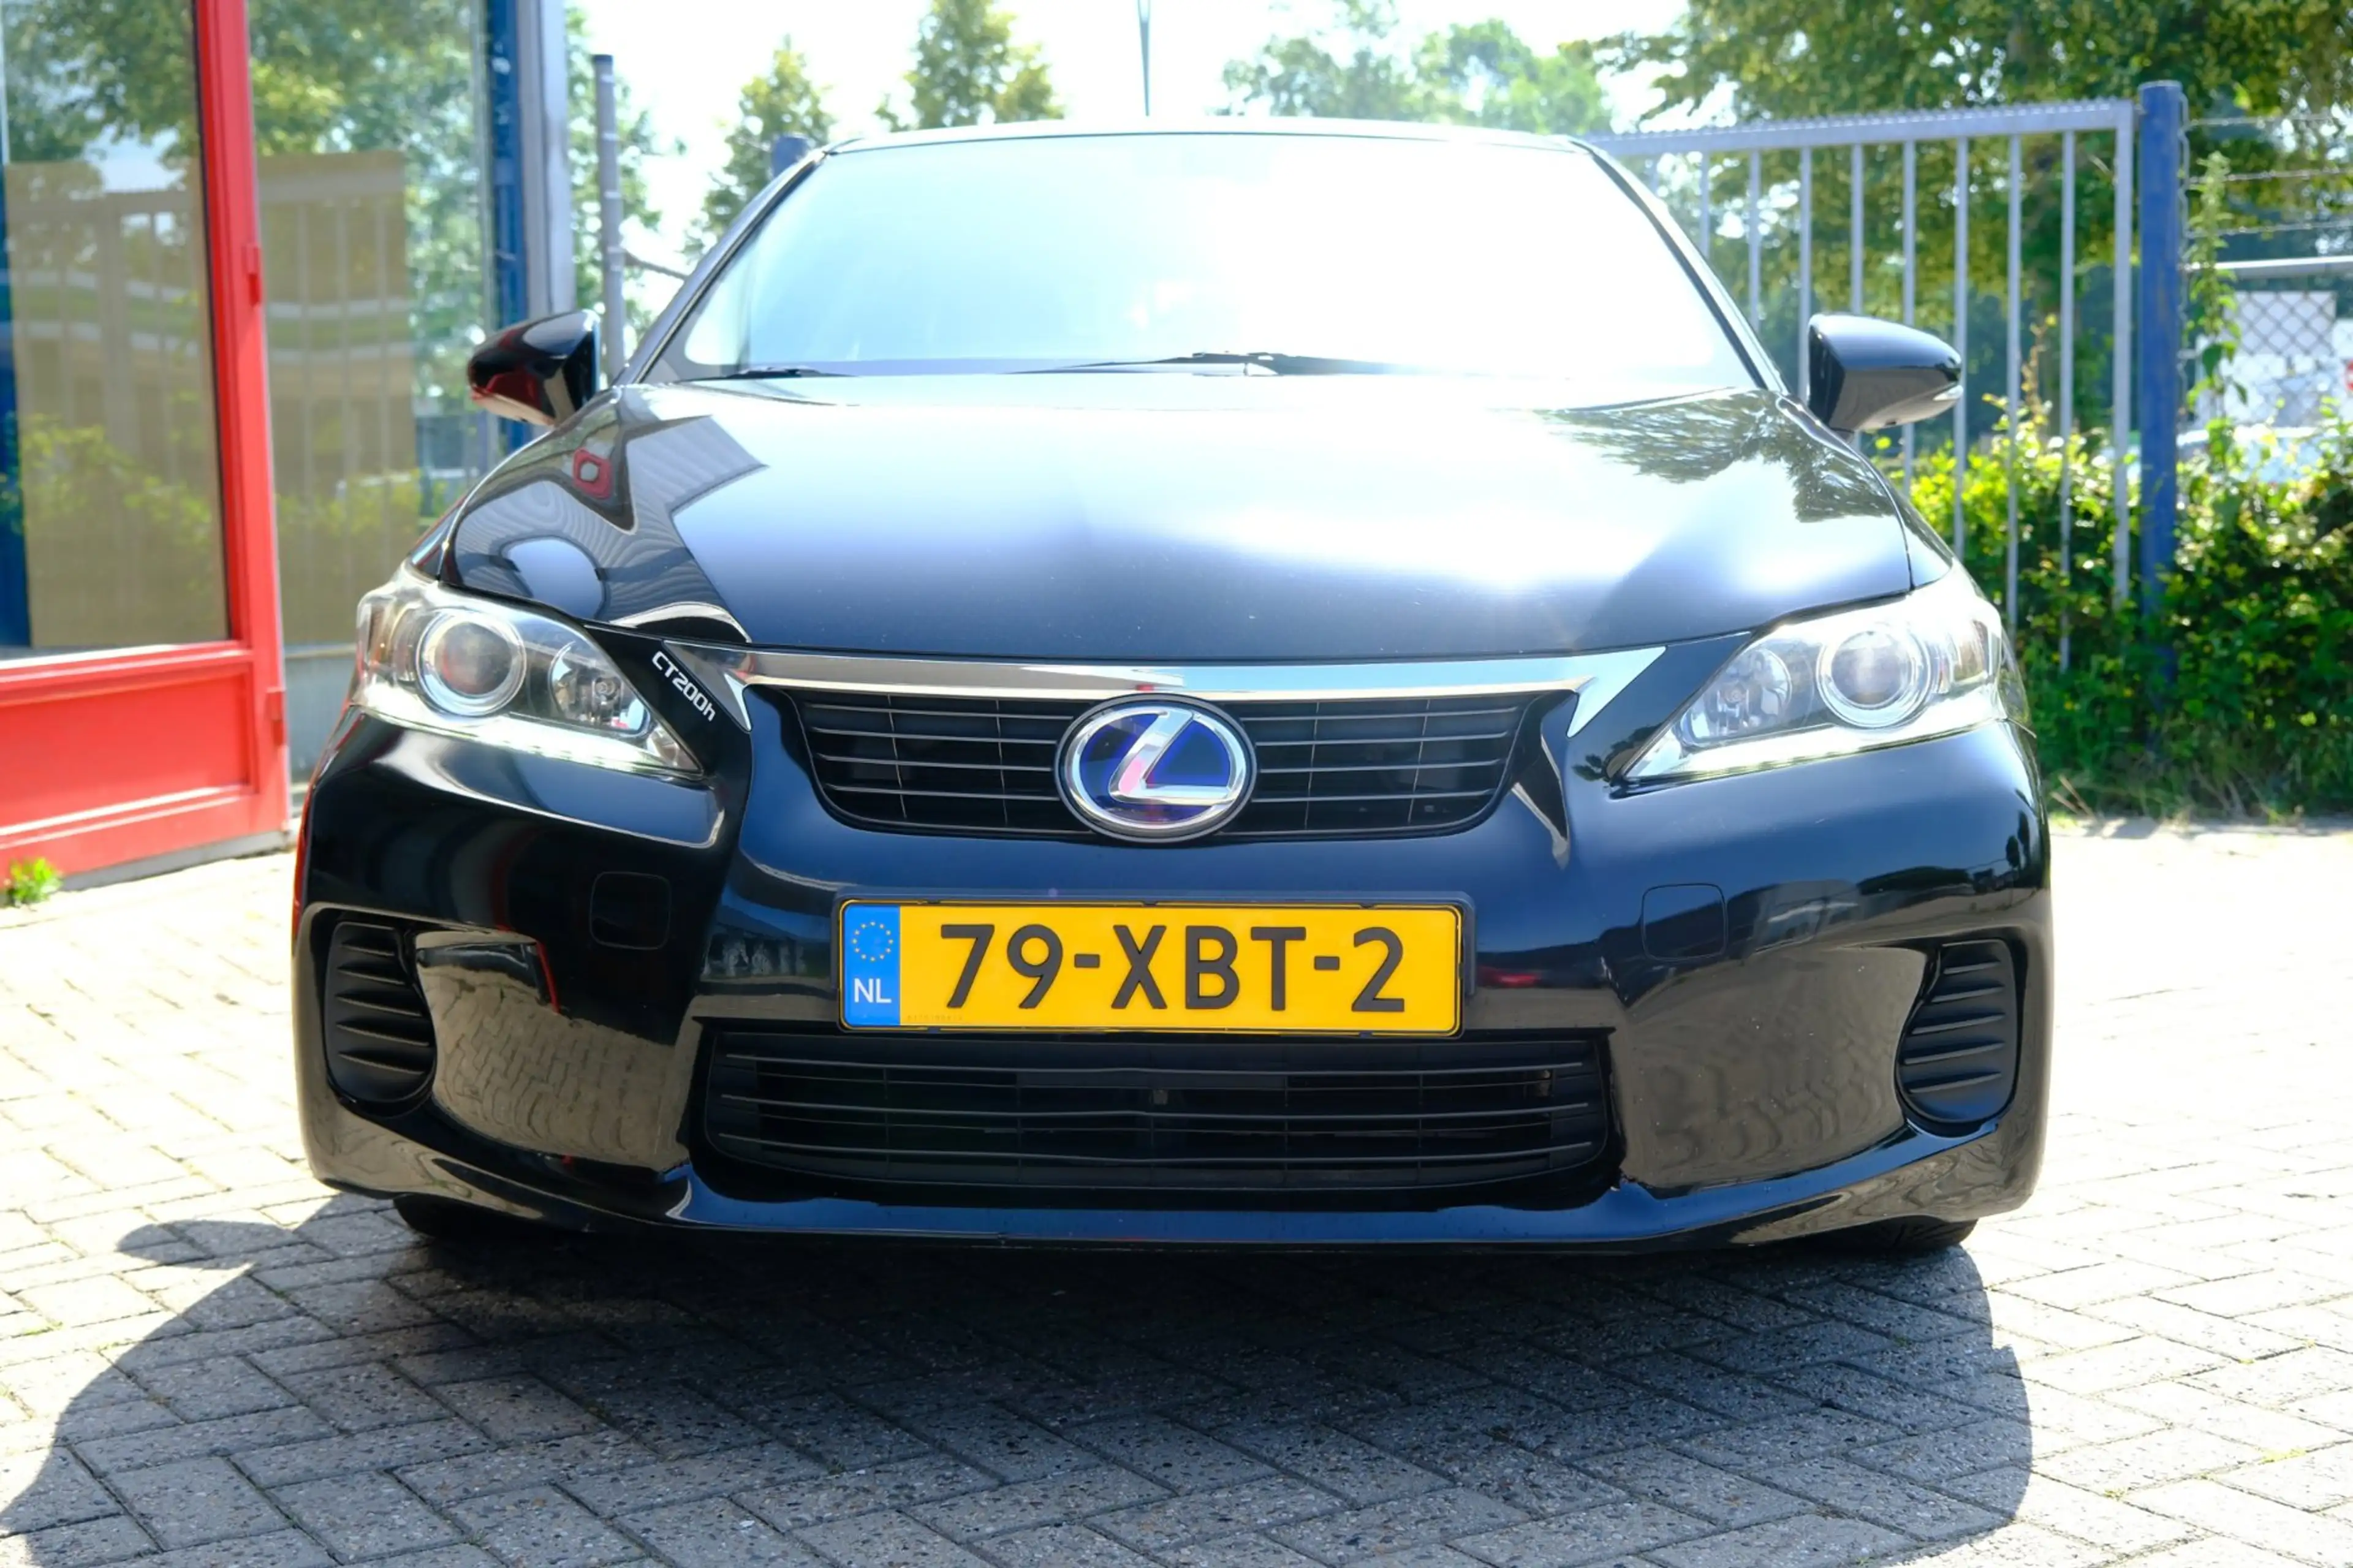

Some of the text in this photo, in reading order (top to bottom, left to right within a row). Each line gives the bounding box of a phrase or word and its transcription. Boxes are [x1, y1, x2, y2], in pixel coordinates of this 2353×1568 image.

[651, 650, 716, 722] CT200h
[853, 978, 892, 1004] NL
[940, 923, 1406, 1013] 79-XBT-2
